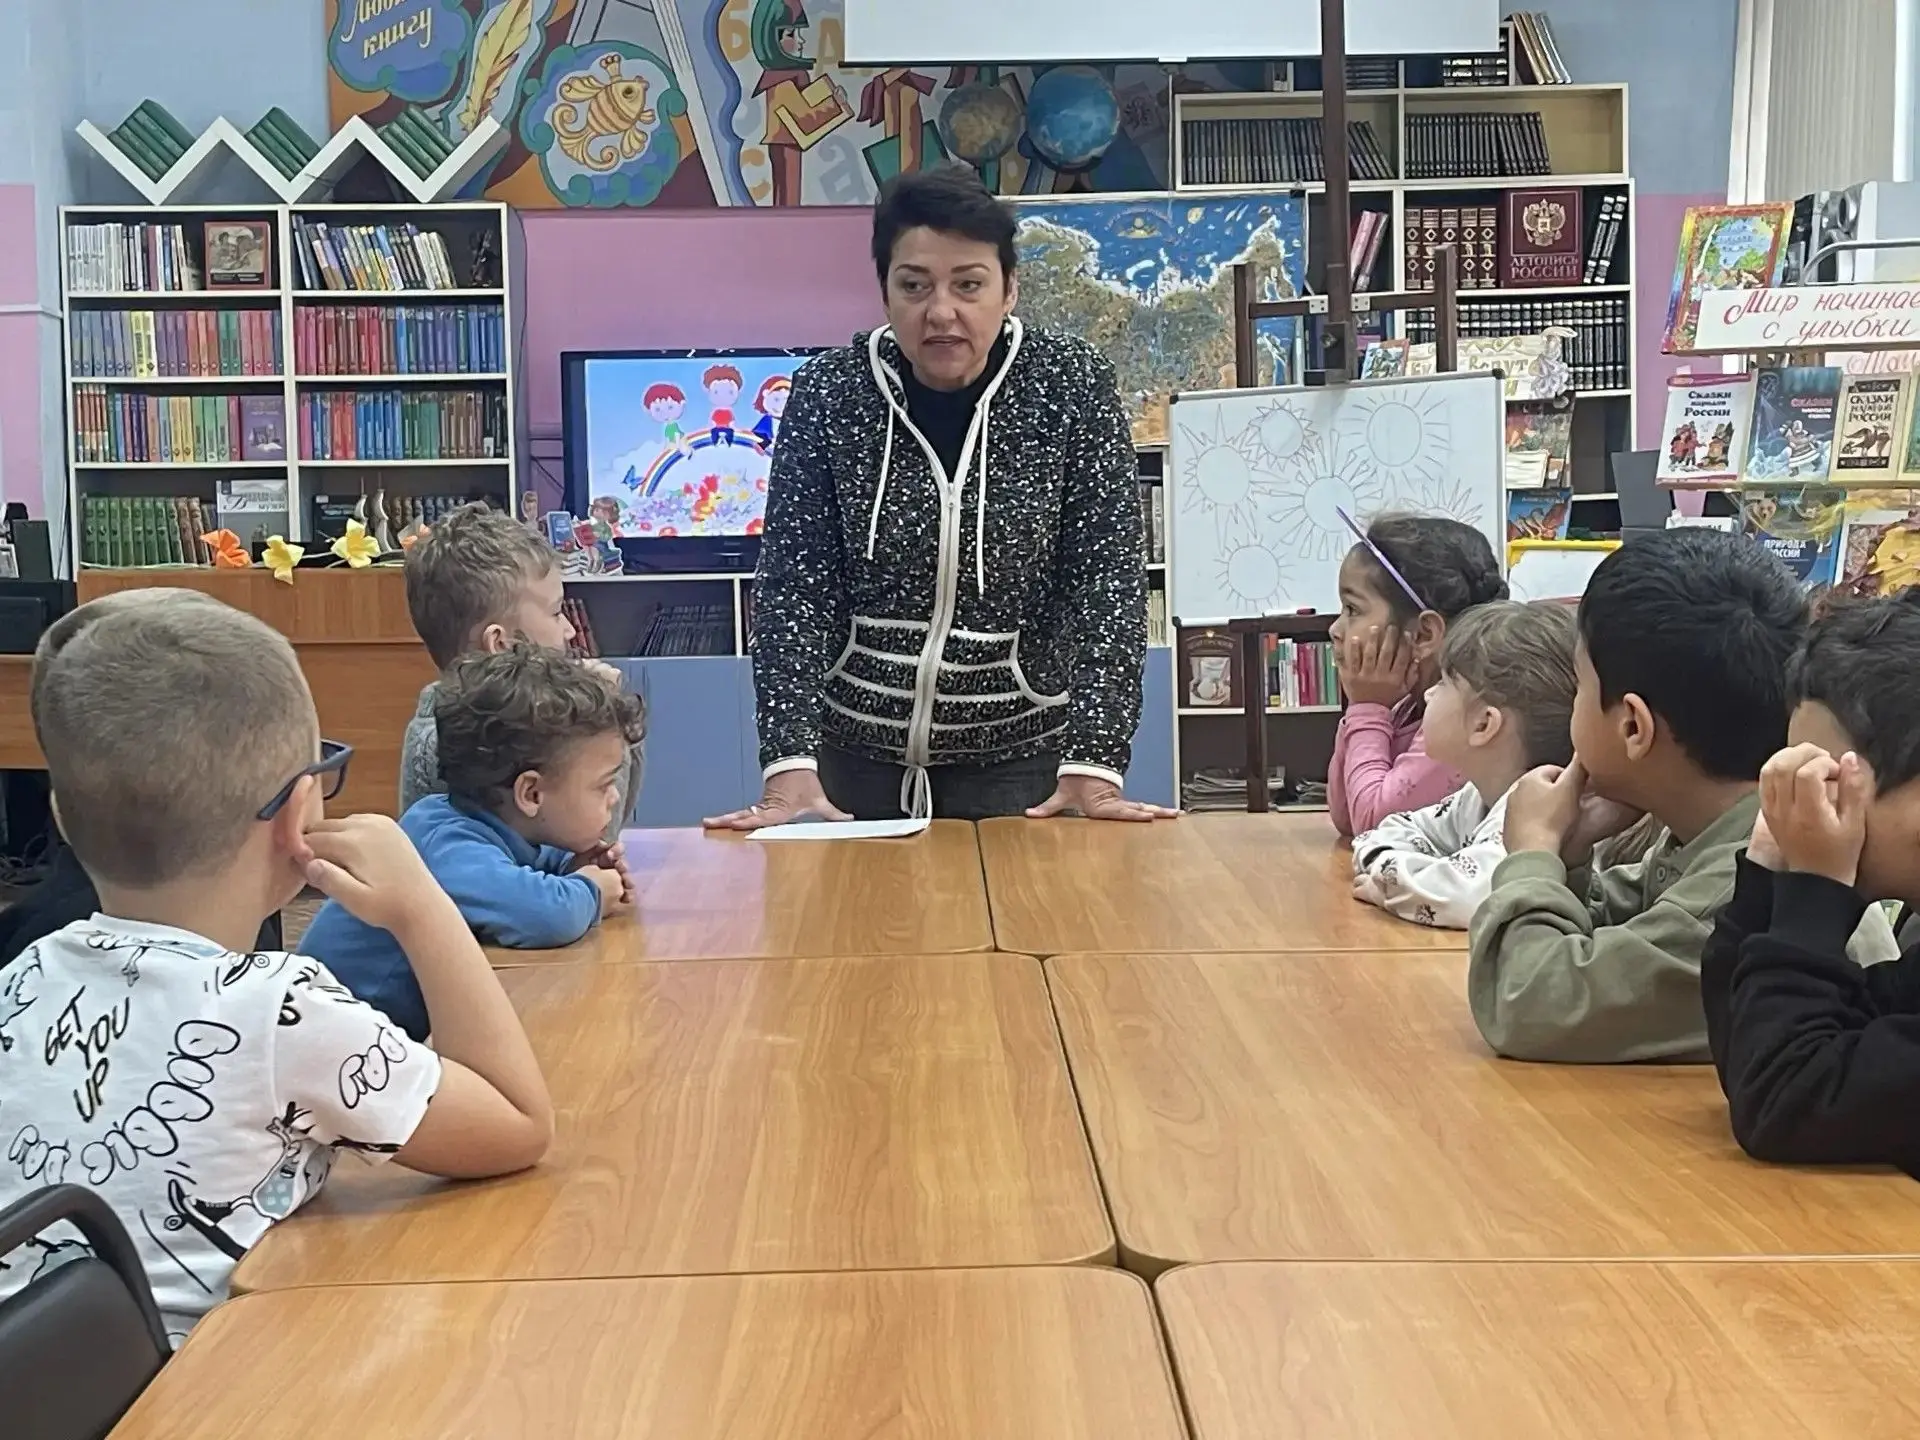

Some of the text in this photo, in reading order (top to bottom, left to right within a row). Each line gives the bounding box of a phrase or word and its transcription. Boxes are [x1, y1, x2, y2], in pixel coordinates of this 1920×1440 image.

[363, 7, 431, 59] книгу
[1510, 256, 1578, 267] ЛЕТОПИСЬ
[1511, 265, 1577, 279] РОССИИ
[1723, 289, 1799, 325] Мир
[1784, 312, 1919, 347] улыбки
[1688, 390, 1732, 399] Сказки
[1684, 407, 1731, 417] России
[1763, 539, 1807, 549] ПРИРОДА
[1770, 548, 1801, 558] ОССИИ
[45, 985, 86, 1066] GET
[75, 997, 130, 1070] YOU
[73, 1057, 109, 1124] UP
